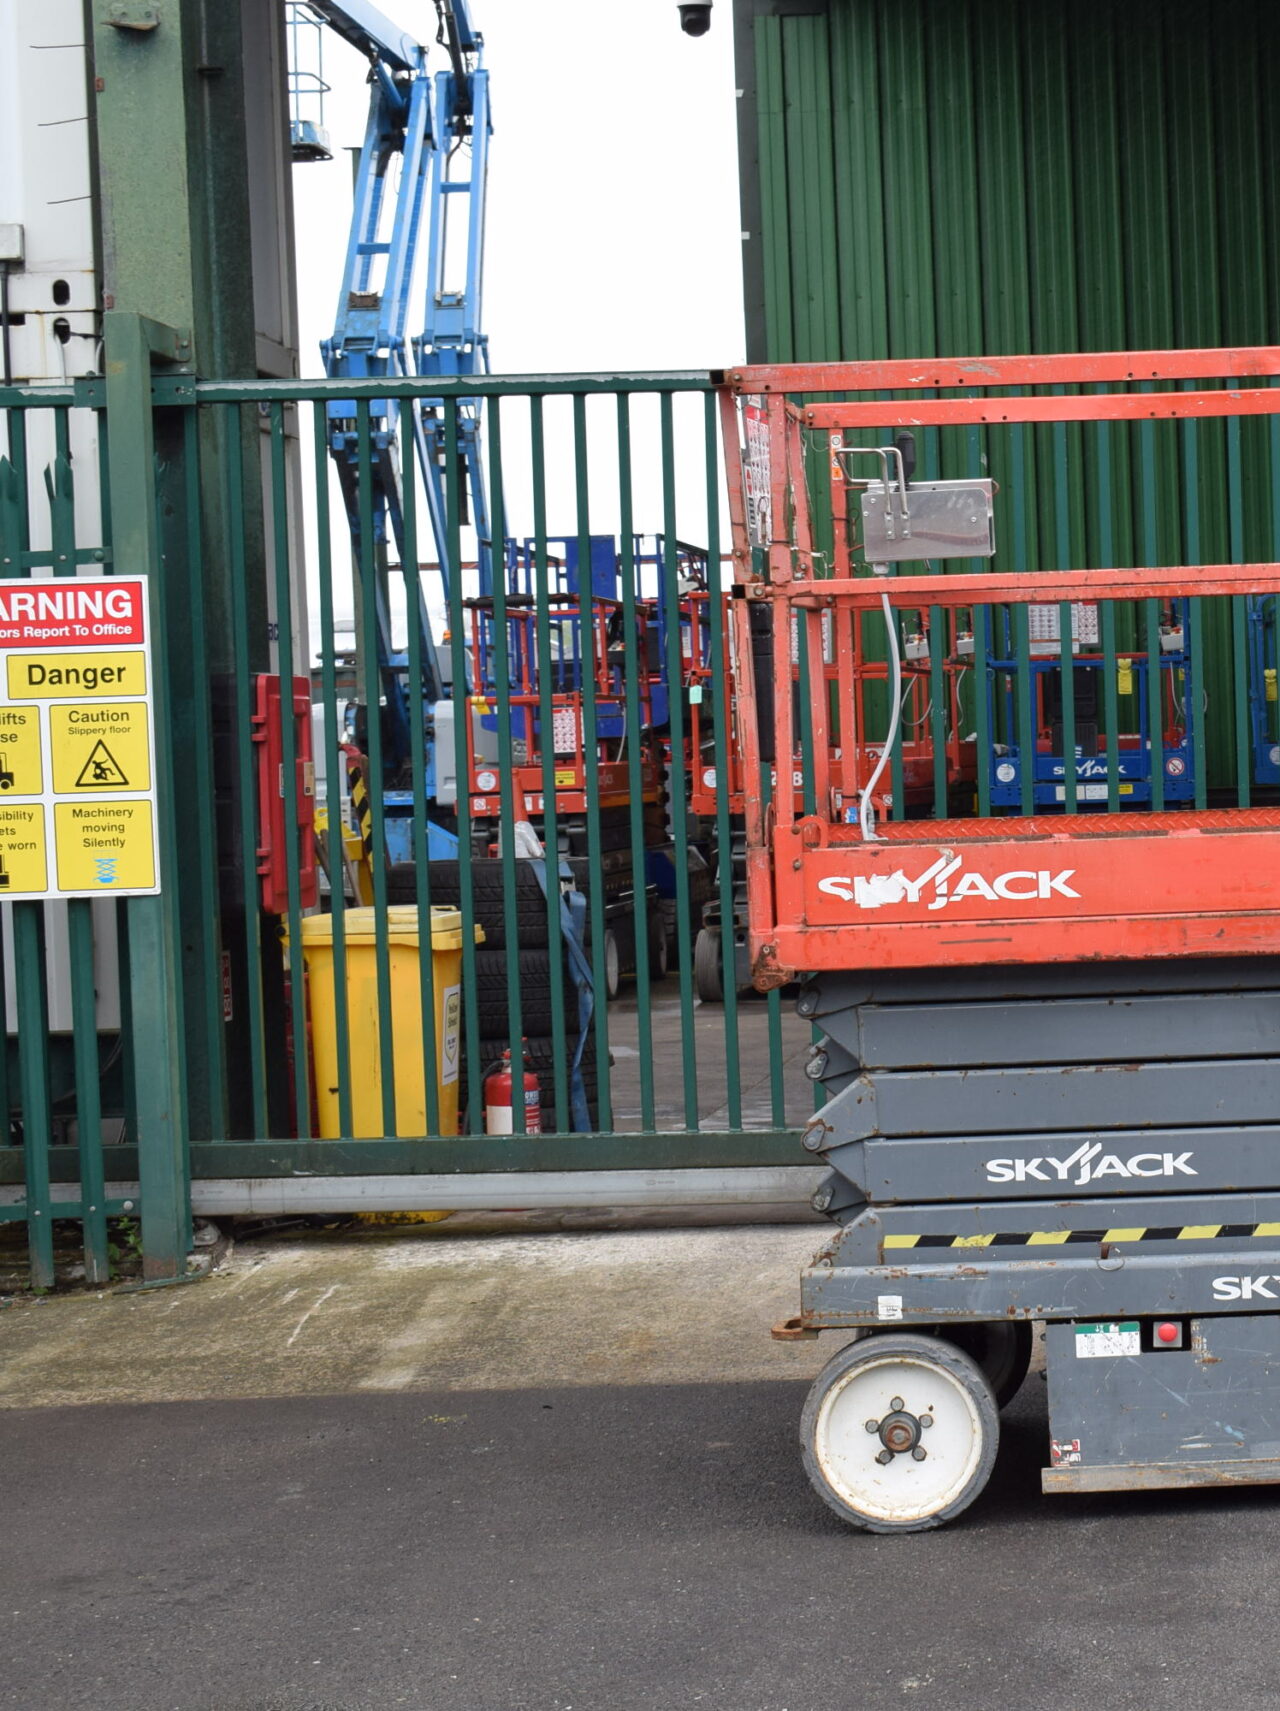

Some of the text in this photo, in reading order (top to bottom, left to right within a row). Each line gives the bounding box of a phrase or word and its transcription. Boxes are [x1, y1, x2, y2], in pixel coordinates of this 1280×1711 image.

[23, 625, 70, 640] Report
[72, 624, 89, 637] To
[92, 623, 133, 637] Office
[27, 663, 127, 690] Danger
[68, 709, 130, 724] Caution
[68, 724, 132, 736] Slippery floor
[72, 806, 134, 821] Machinery
[82, 822, 125, 836] moving
[8, 842, 37, 850] worn
[83, 837, 126, 850] Silently
[985, 1140, 1199, 1186] SKYJACK
